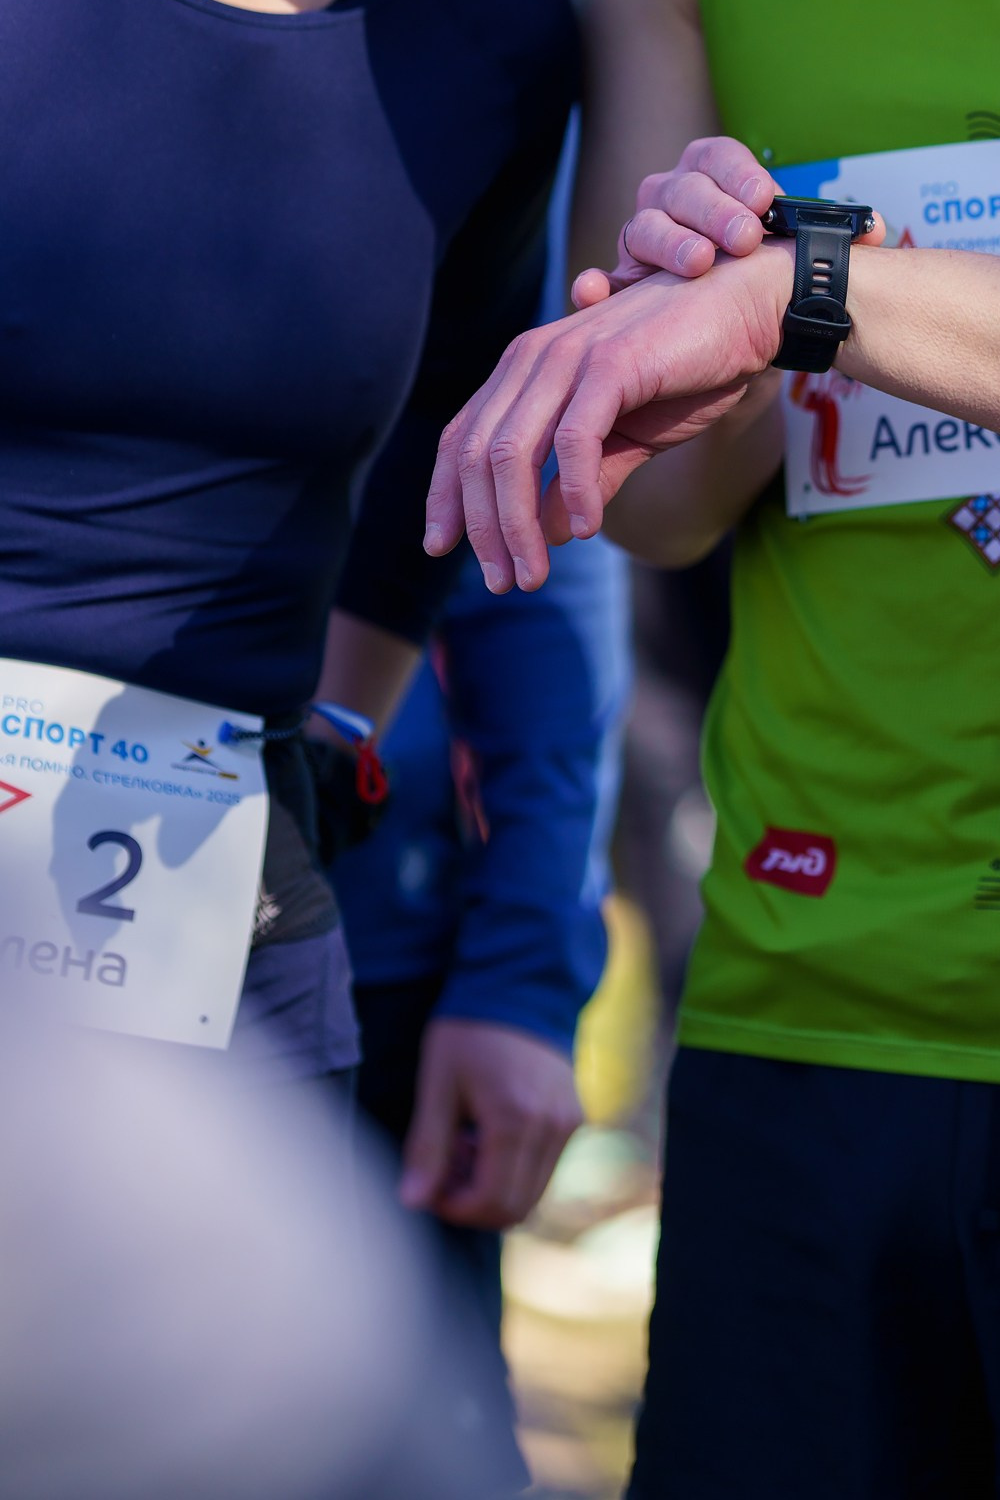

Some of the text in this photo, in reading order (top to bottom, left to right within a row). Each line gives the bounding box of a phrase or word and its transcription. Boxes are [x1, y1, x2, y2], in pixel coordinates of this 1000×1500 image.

[2, 696, 44, 714] PRO
[1, 714, 149, 764] СПОРТ 40
[76, 829, 142, 922] 2
